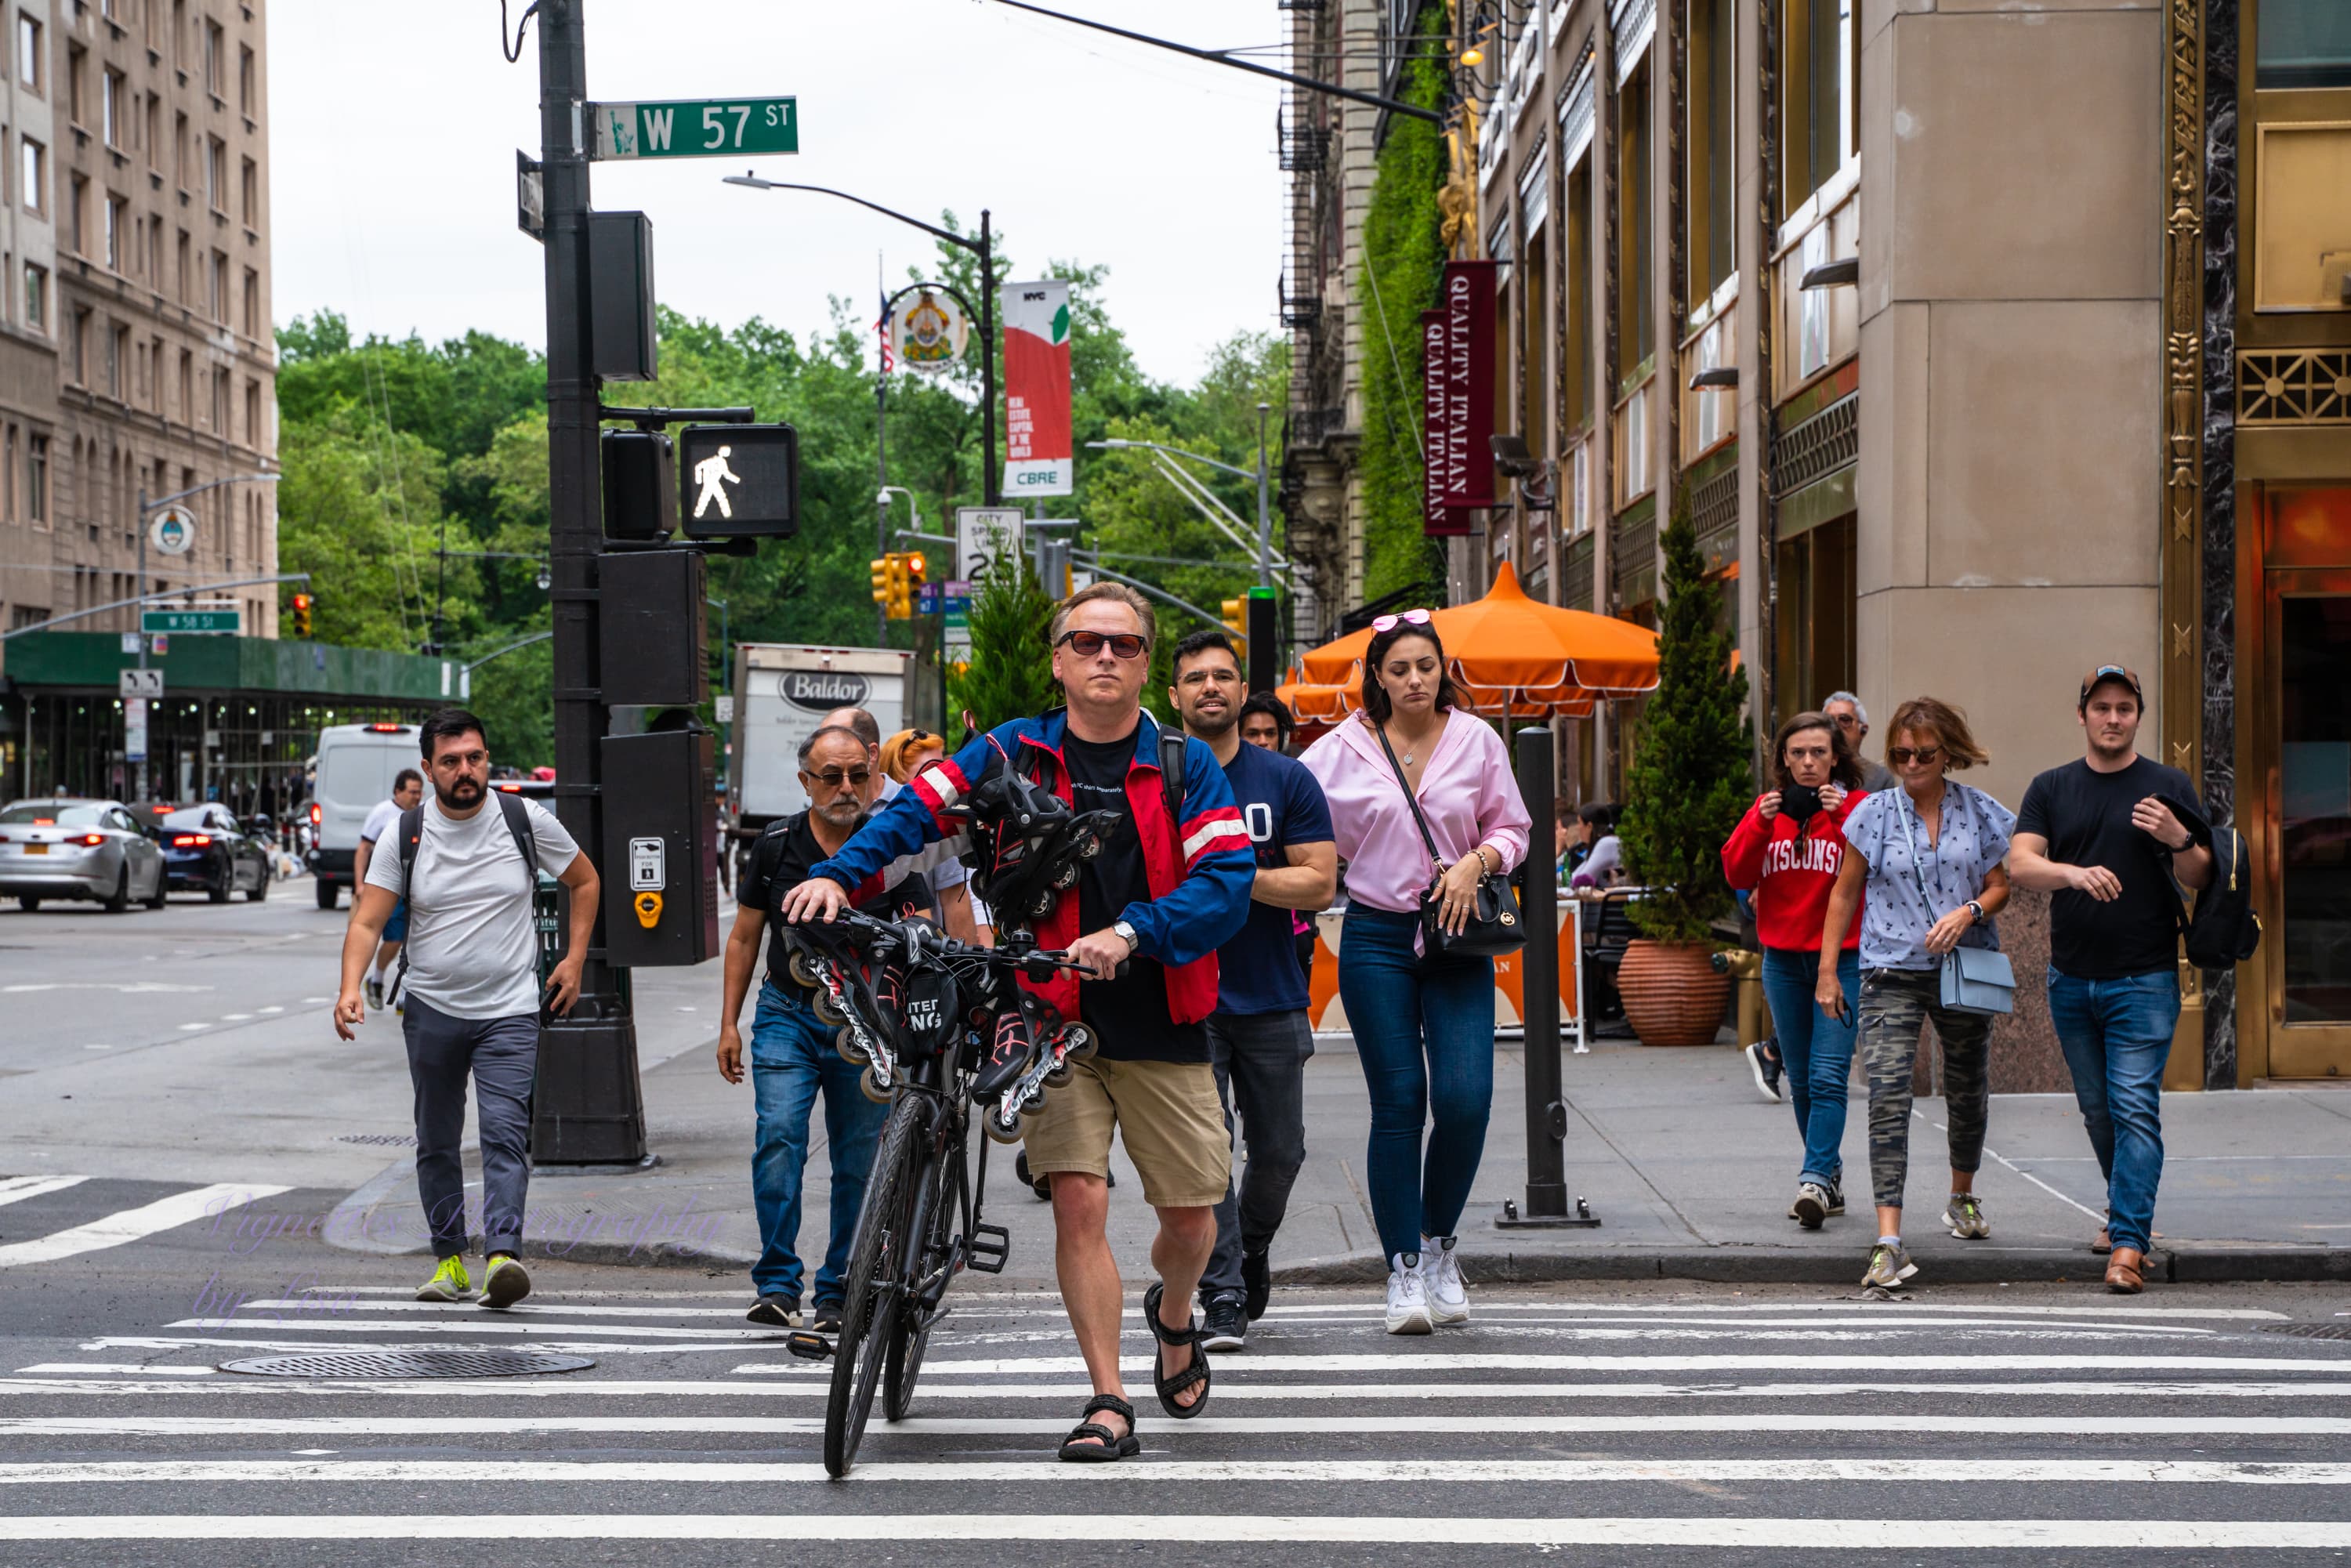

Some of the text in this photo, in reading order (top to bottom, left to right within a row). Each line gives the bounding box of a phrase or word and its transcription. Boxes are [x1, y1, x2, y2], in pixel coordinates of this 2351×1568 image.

[643, 104, 789, 150] W 57 ST
[1023, 292, 1045, 301] NYC
[1449, 276, 1470, 494] QUALITY ITALIAN
[1427, 324, 1447, 521] QUALITY ITALIAN
[1017, 472, 1057, 484] CBRE
[793, 675, 863, 700] Baldor
